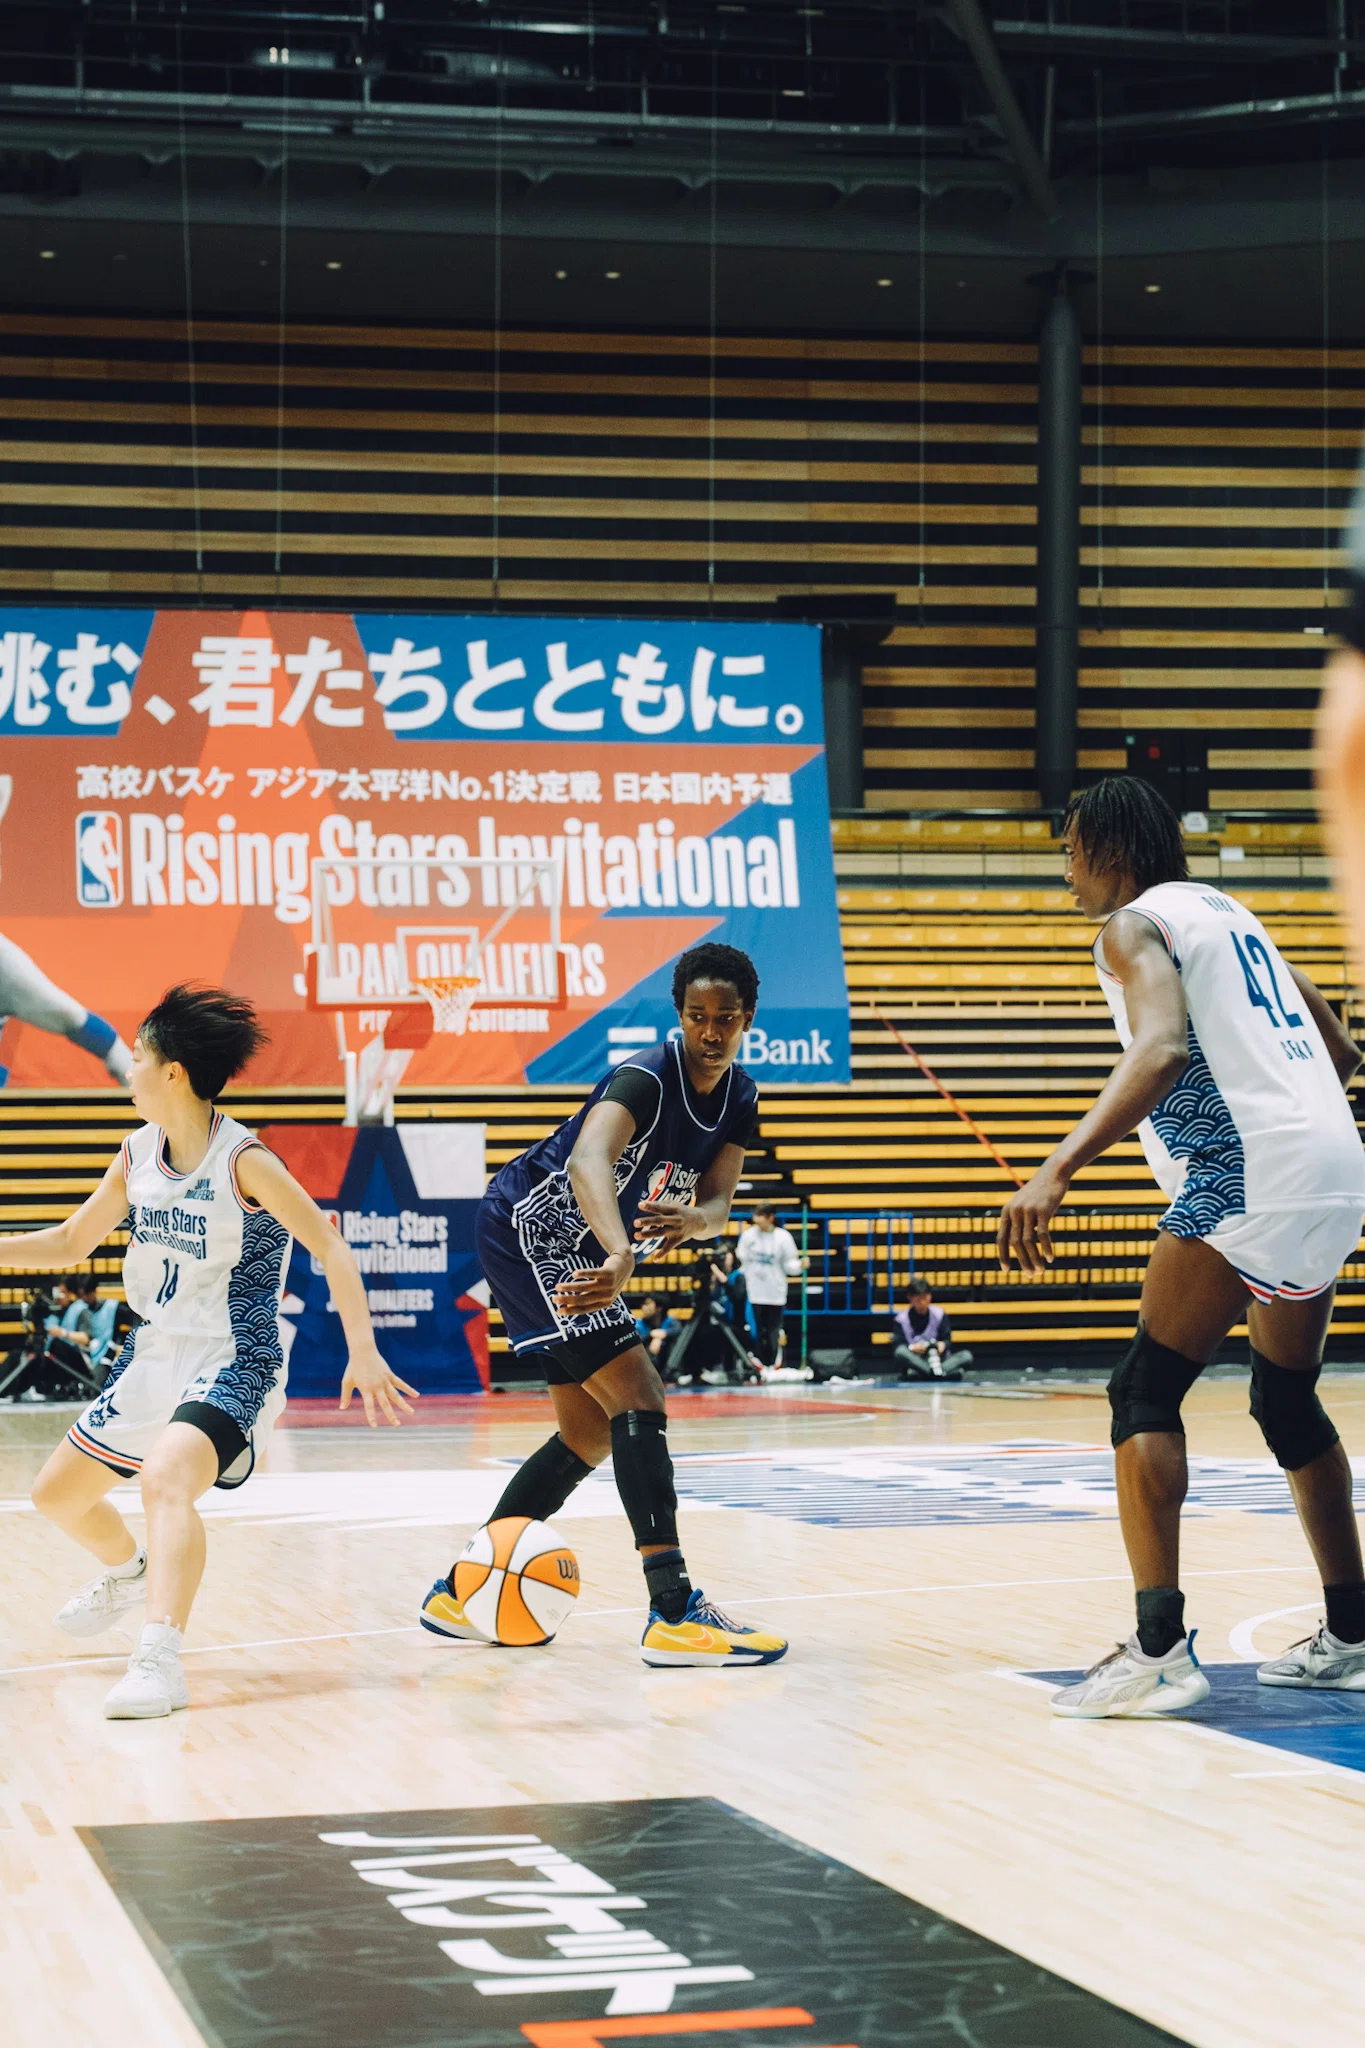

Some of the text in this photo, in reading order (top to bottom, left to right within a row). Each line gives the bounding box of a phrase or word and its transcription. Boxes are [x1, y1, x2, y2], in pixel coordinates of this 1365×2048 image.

[76, 764, 793, 806] 高校バスケ アジア太平洋No.1決定戦 日本国内予選
[129, 812, 801, 924] Rising Stars Invitational
[1230, 930, 1304, 1028] 42
[172, 1206, 206, 1236] Stars
[342, 1209, 448, 1247] Rising Stars
[350, 1241, 448, 1274] nvitational
[155, 1257, 179, 1308] 14
